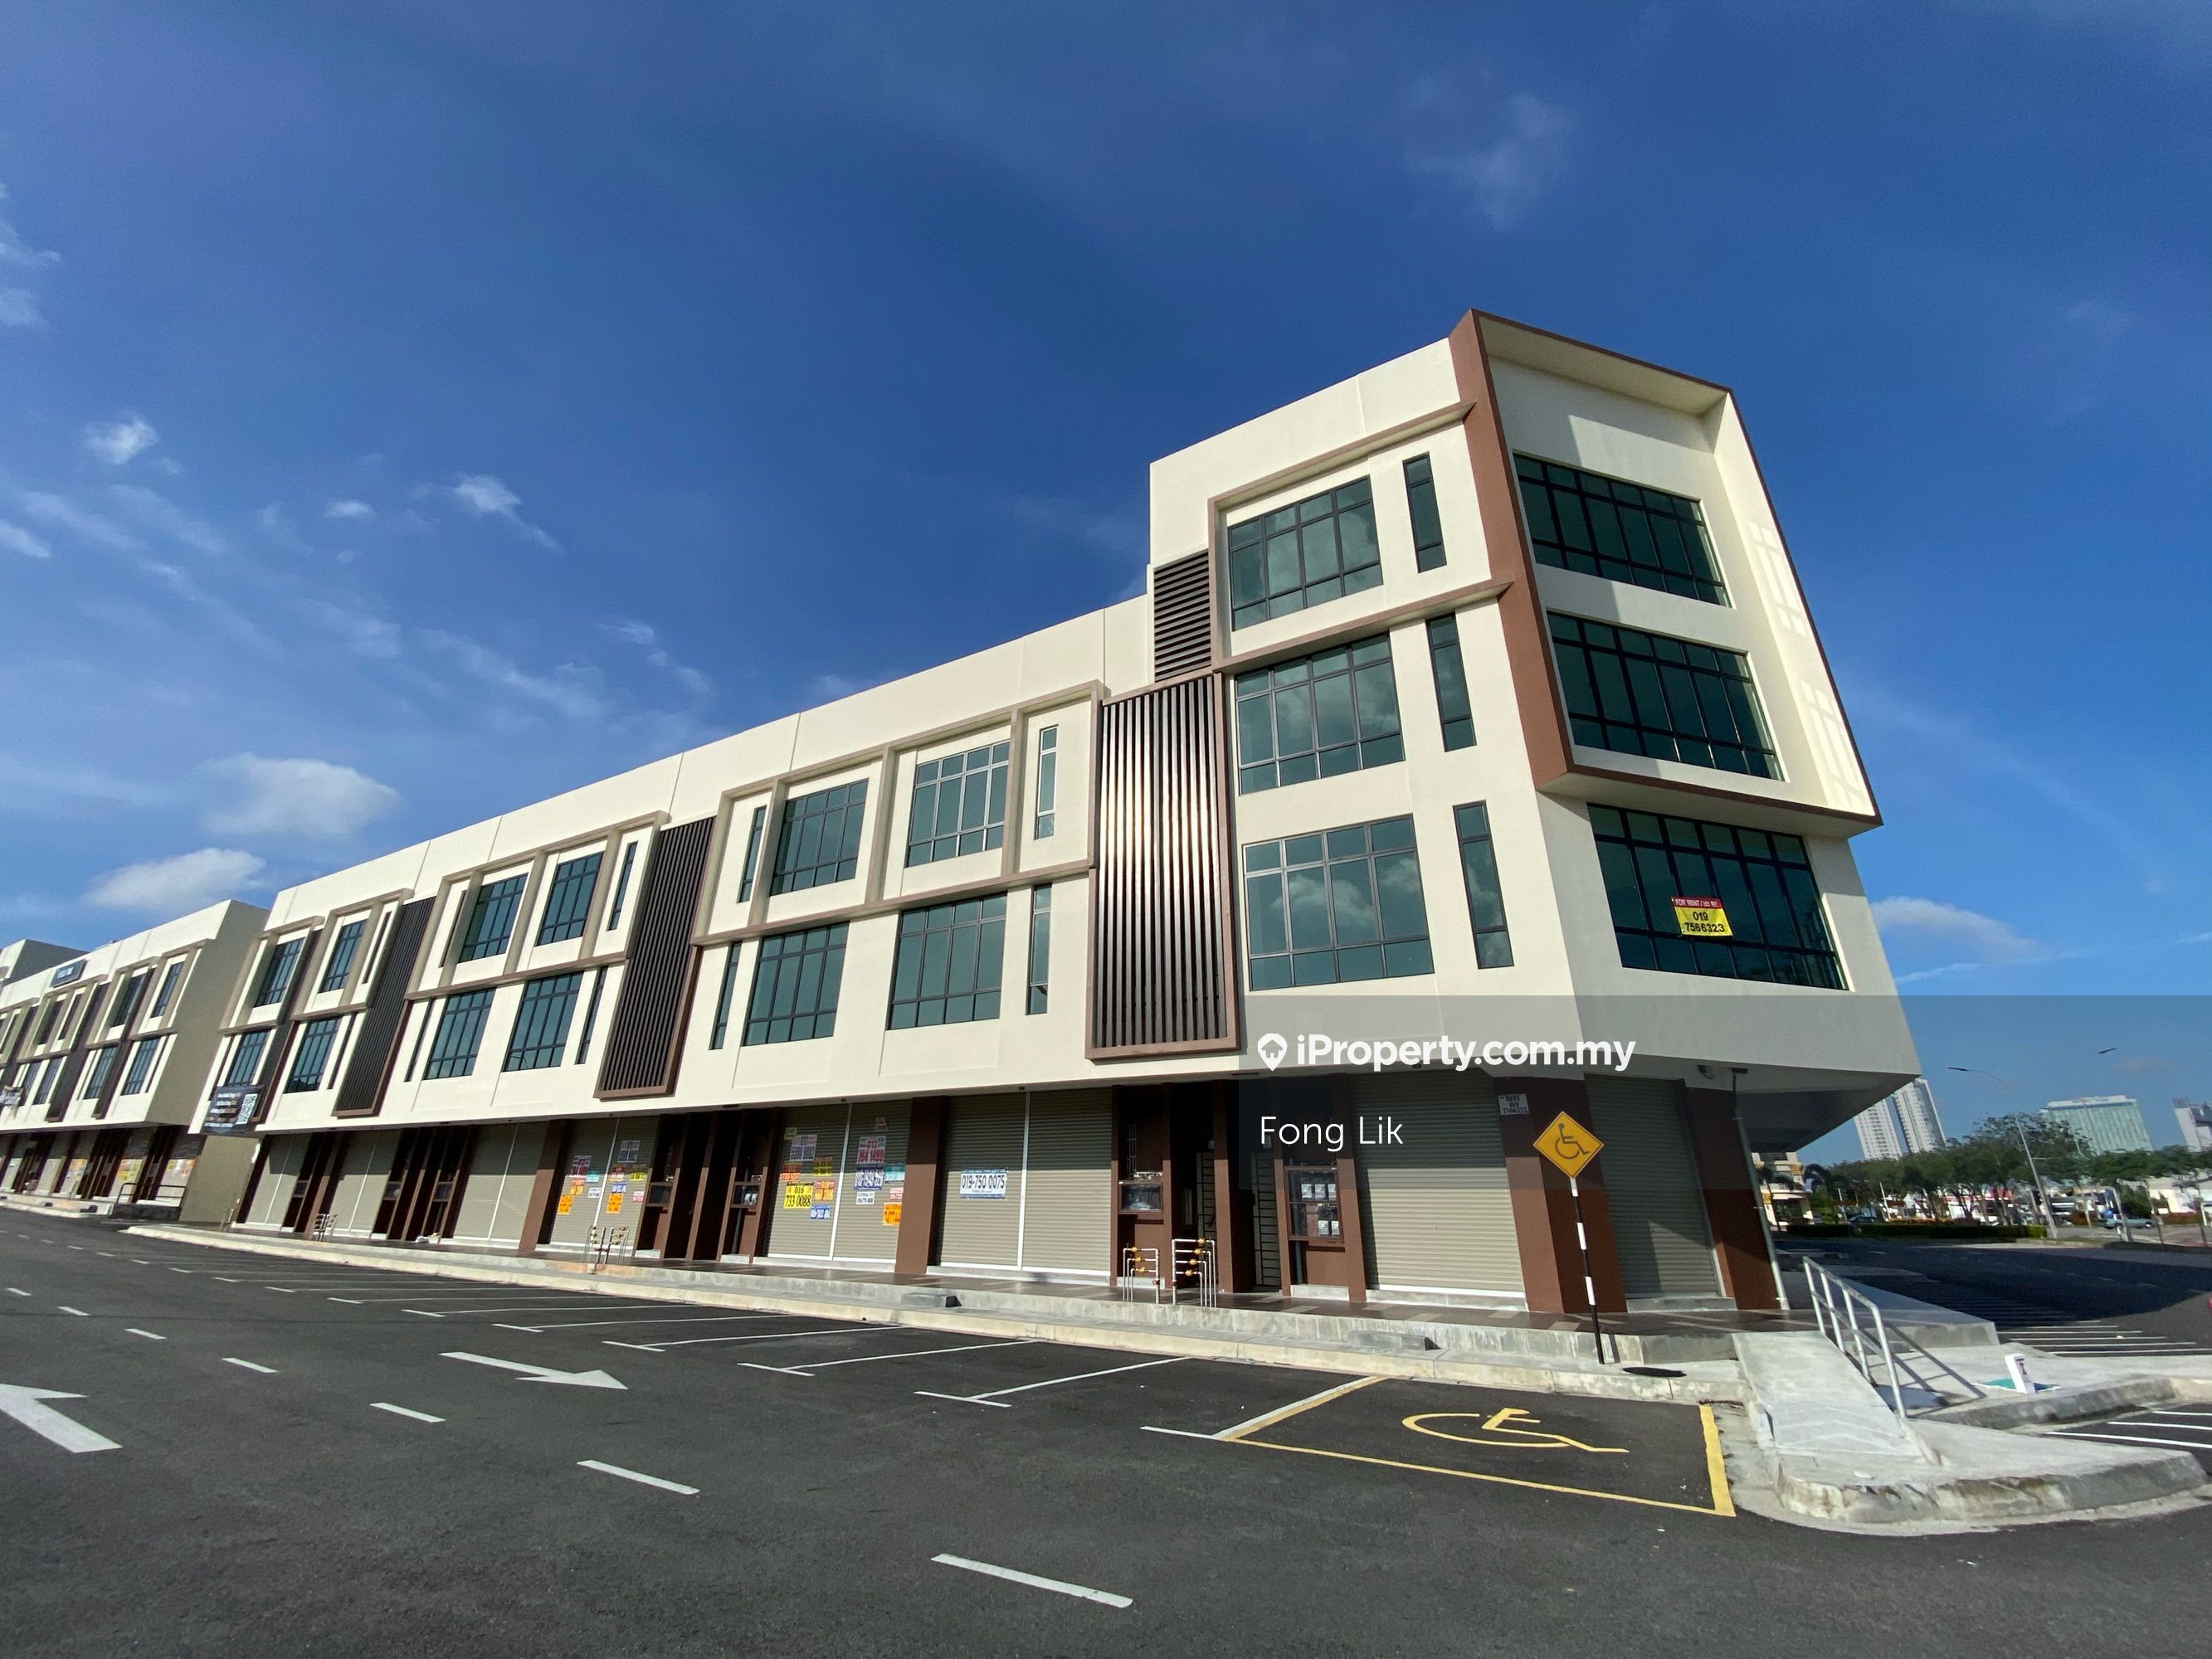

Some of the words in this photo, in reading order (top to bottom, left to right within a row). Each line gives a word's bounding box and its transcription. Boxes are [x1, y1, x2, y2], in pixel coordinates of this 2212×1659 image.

[1693, 912, 1708, 921] 019
[1684, 922, 1725, 932] 7566323
[962, 1175, 987, 1188] 019-750
[988, 1175, 1005, 1188] 0075
[785, 1195, 795, 1207] 733
[797, 1195, 811, 1207] 0088
